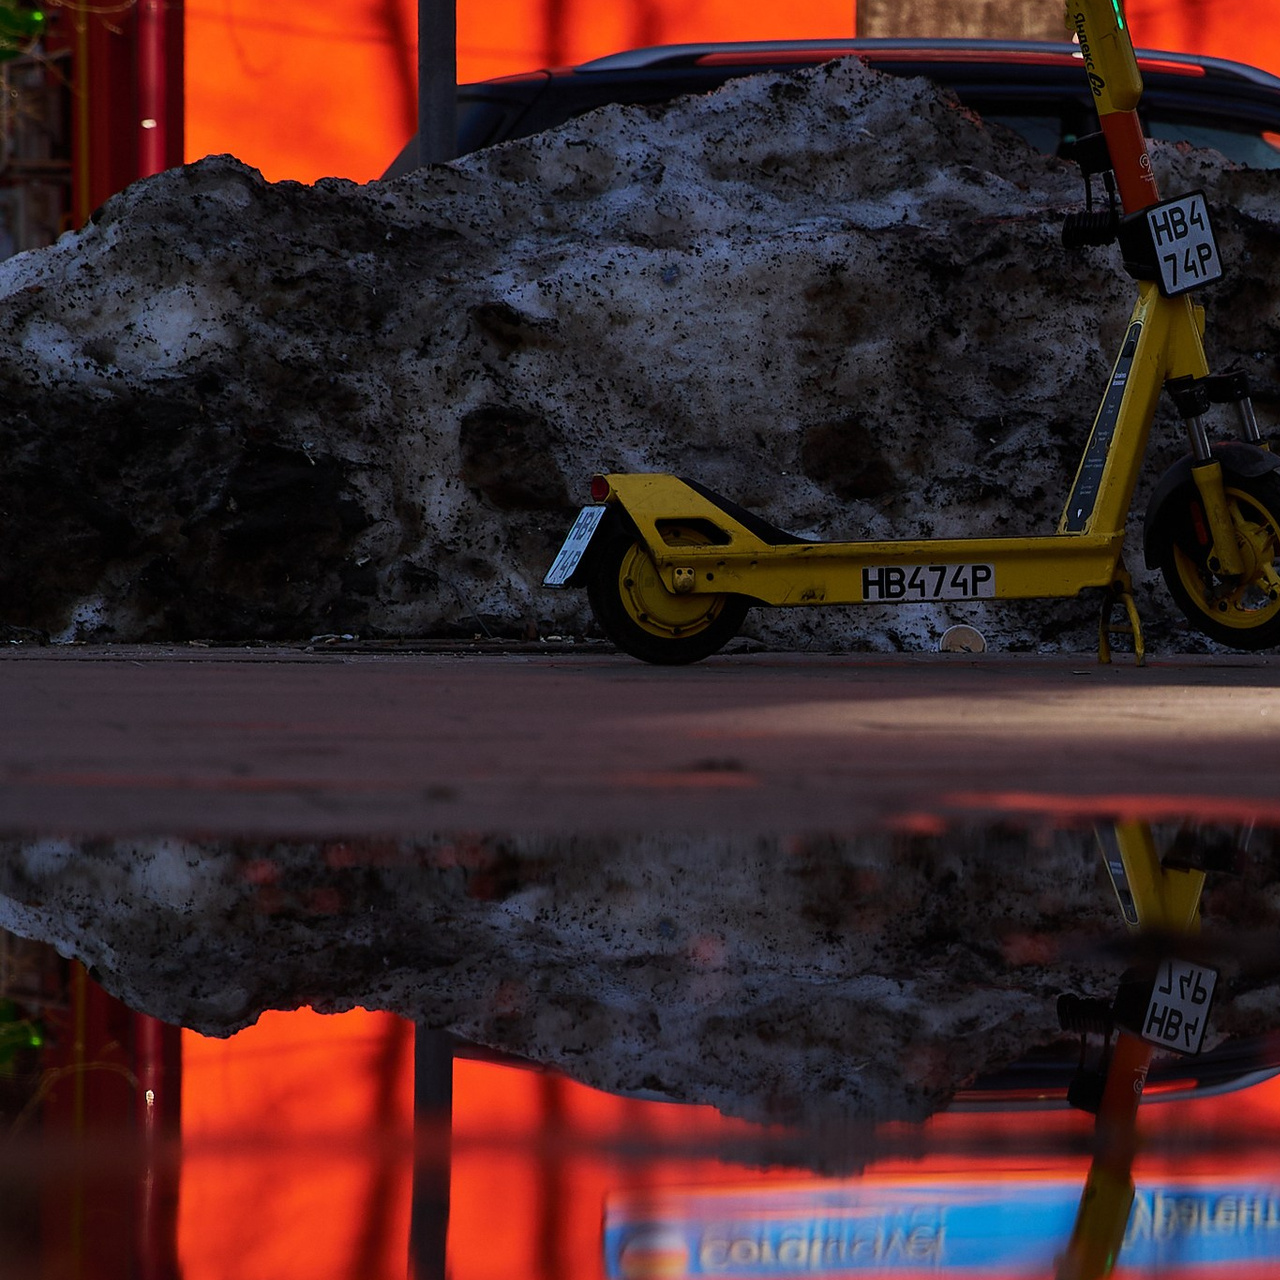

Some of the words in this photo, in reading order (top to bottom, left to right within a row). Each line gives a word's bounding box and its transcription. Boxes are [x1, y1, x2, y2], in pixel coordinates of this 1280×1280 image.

[1073, 12, 1096, 70] Яндекс
[1088, 71, 1105, 97] Go
[862, 565, 992, 599] HB474P
